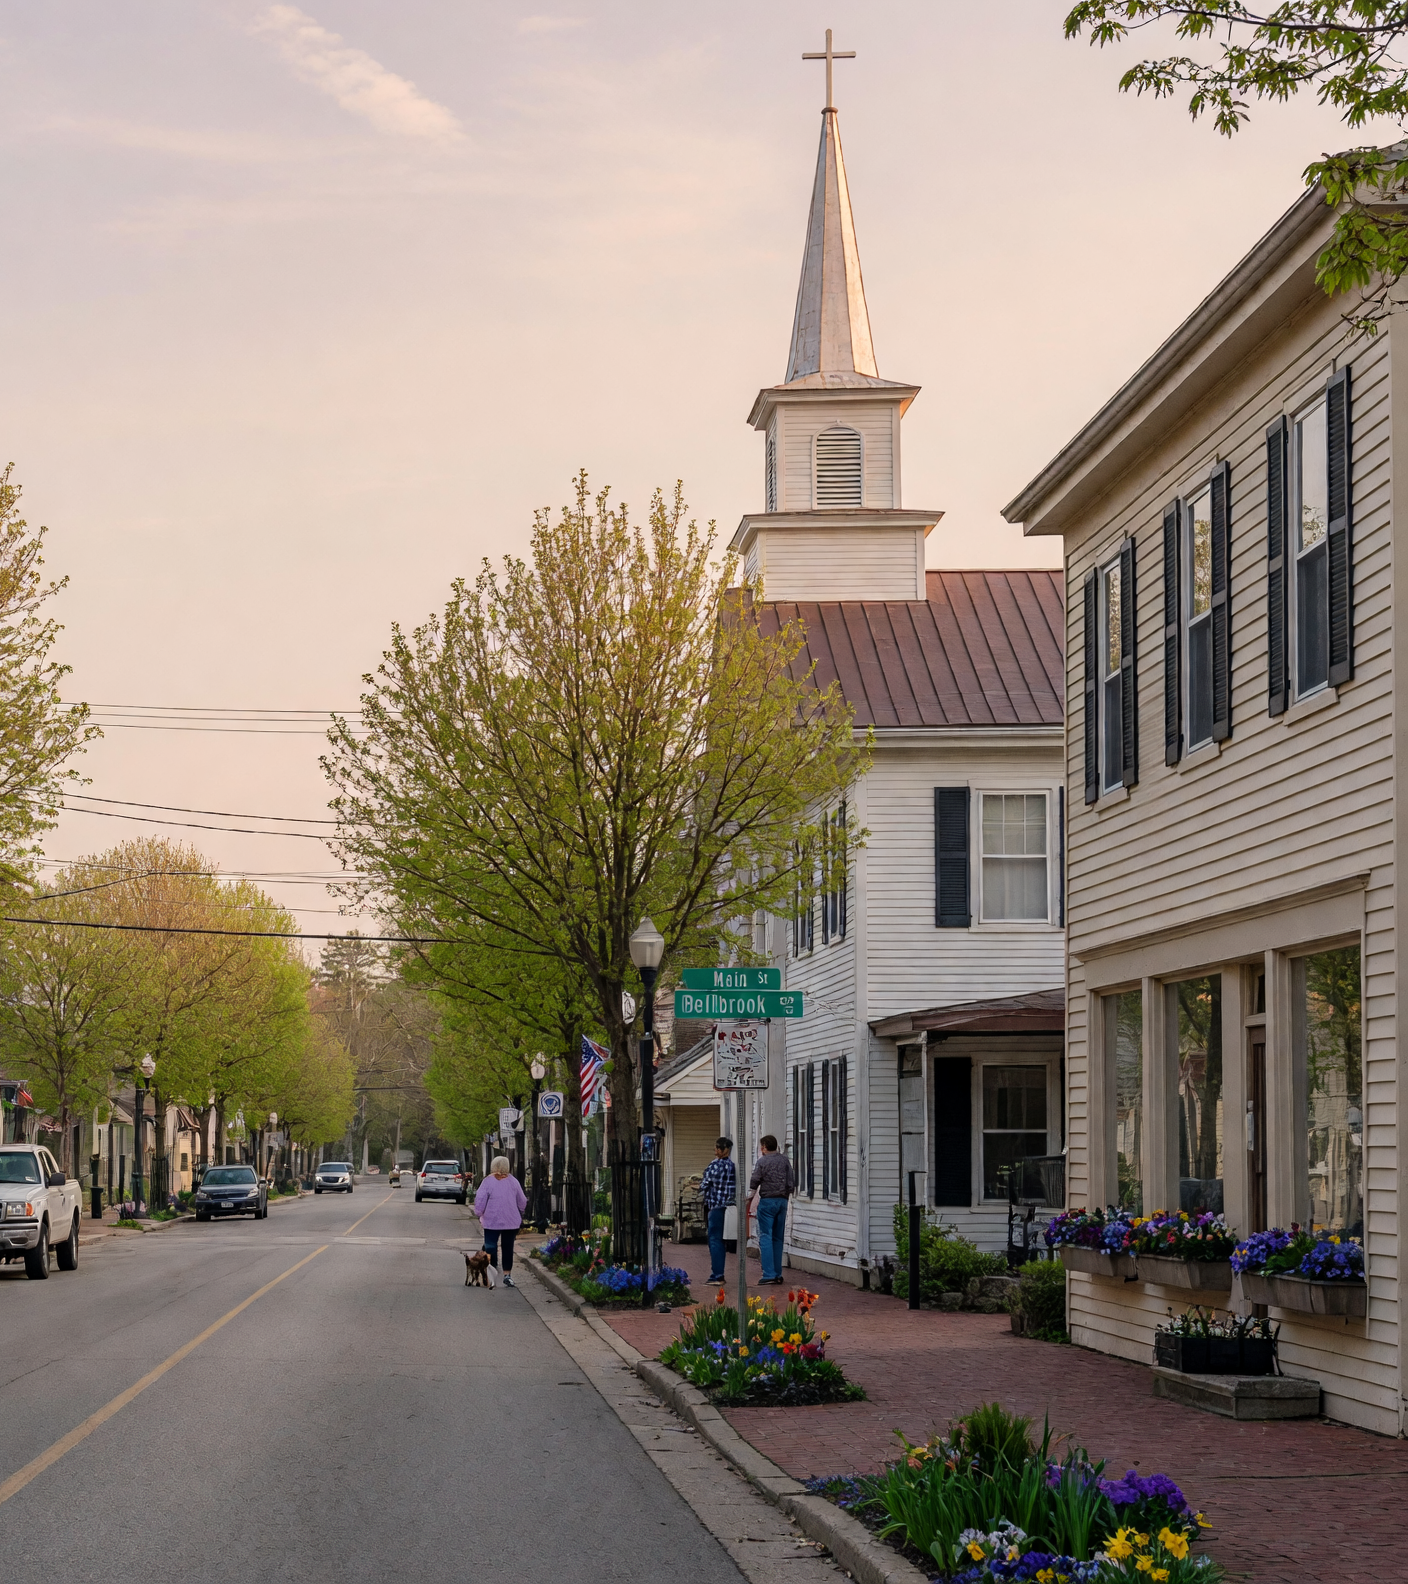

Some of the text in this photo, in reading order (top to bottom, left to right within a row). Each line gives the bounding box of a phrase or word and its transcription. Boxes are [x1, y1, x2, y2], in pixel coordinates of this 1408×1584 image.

[714, 971, 768, 987] Main St
[682, 994, 765, 1013] Bellbrook
